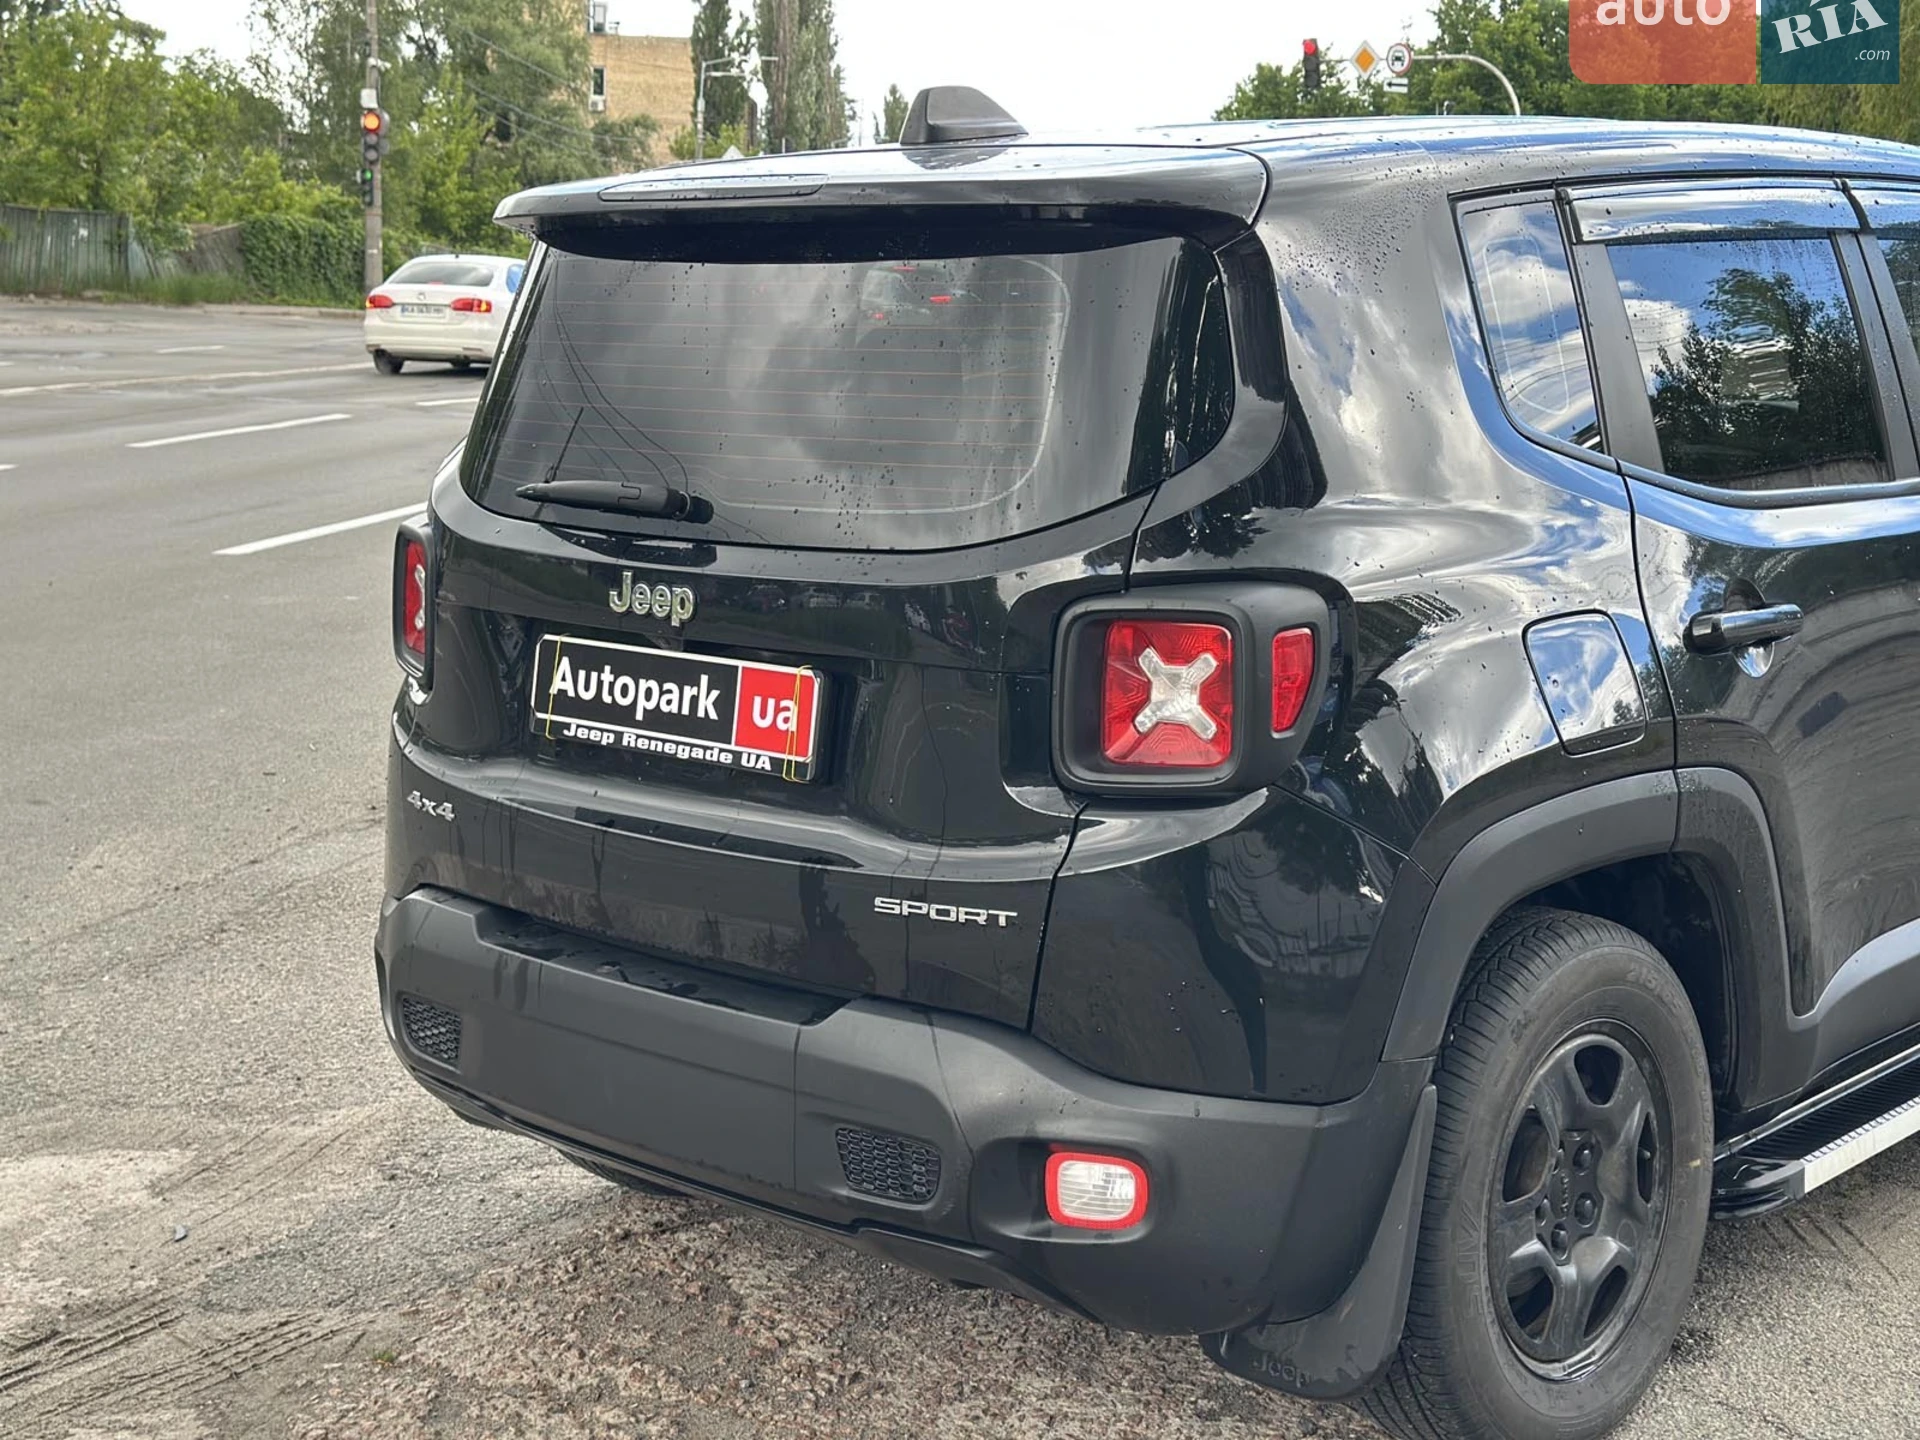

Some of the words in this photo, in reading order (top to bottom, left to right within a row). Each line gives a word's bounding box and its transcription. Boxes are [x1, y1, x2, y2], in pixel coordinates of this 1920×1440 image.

[608, 570, 696, 627] Jeep
[550, 655, 721, 721] Autopark
[751, 694, 798, 732] ua
[562, 722, 615, 745] Jeep
[621, 730, 734, 765] Renegade
[740, 753, 772, 771] UA
[873, 896, 1019, 927] SPORT
